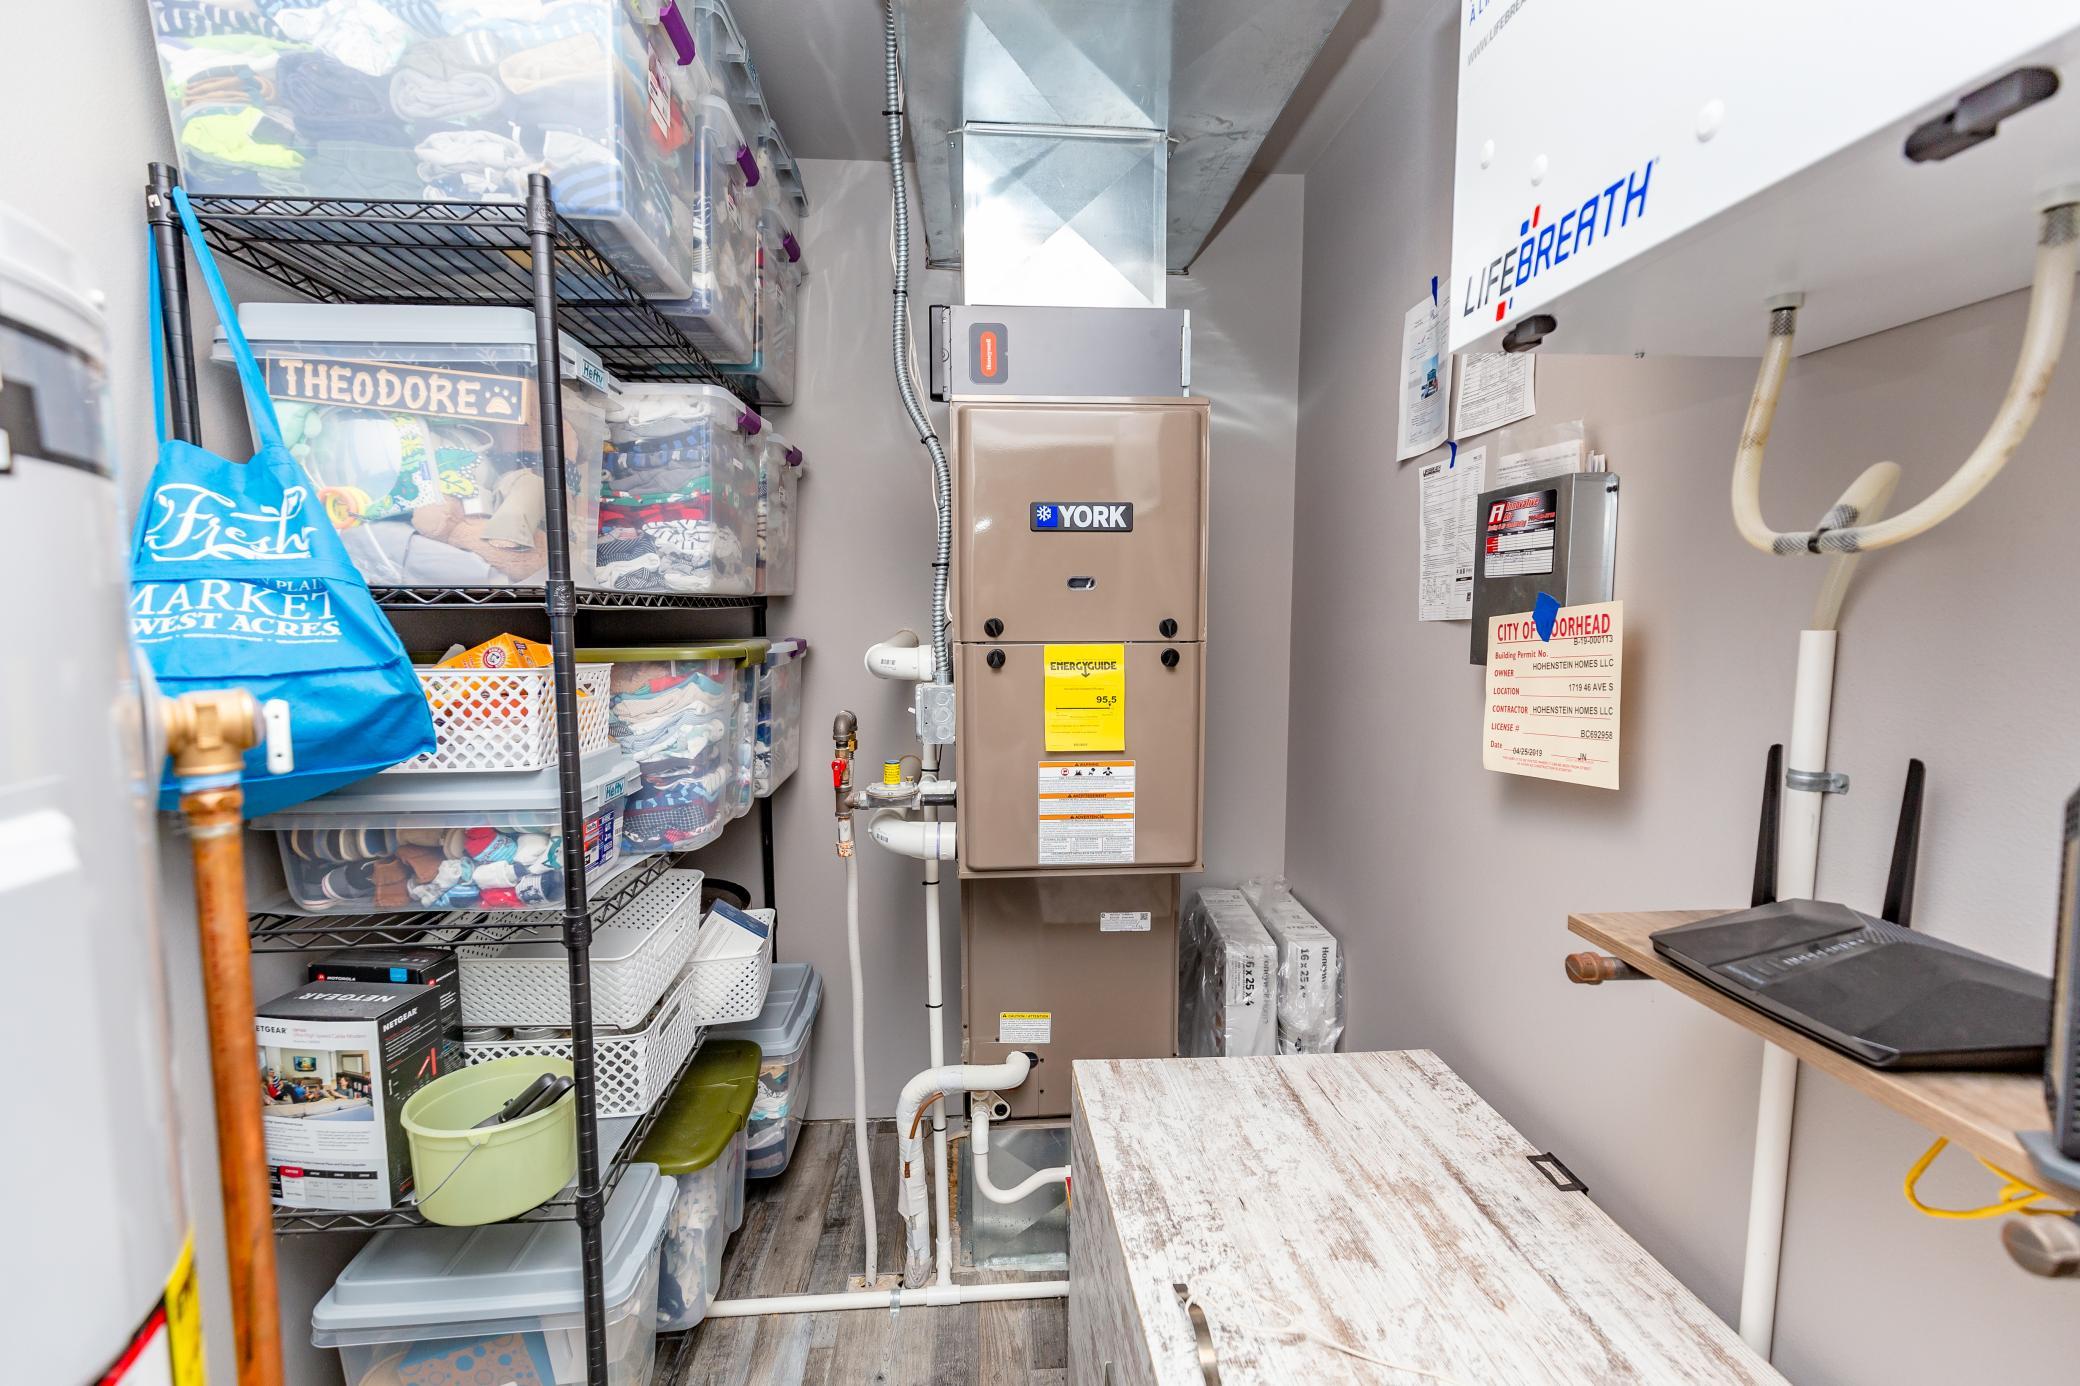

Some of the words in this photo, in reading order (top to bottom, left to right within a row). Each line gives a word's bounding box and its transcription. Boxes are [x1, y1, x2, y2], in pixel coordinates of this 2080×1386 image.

[1463, 159, 1654, 318] LIFEBREATH
[583, 361, 604, 386] Hefty
[279, 359, 481, 415] THEODORE
[145, 483, 318, 554] Fresh
[1058, 505, 1127, 528] YORK
[129, 611, 223, 636] WEST
[228, 613, 343, 637] ACRES
[1497, 622, 1519, 642] CITY
[1522, 621, 1536, 639] OF
[1551, 613, 1611, 638] OORHEAD
[1495, 651, 1516, 661] Building
[1517, 651, 1536, 659] Permit
[1538, 649, 1549, 658] No.
[1050, 661, 1117, 673] ENERGYGUIDE
[1532, 661, 1574, 671] HOHENSTEIN
[1574, 659, 1598, 669] HOMES
[1600, 658, 1614, 668] LLC
[1494, 669, 1514, 677] OWNER
[1493, 687, 1520, 696] LOCATION
[1568, 683, 1583, 692] 1719
[1583, 683, 1592, 692] 46
[1592, 682, 1607, 692] AVE
[1608, 682, 1614, 691] S
[1492, 705, 1529, 714] CONTRACTOR
[1532, 705, 1573, 715] HOHENSTEIN
[1574, 706, 1598, 715] HOMES
[1599, 706, 1614, 716] LLC
[1490, 722, 1514, 731] LICENSE
[1490, 740, 1503, 749] Date
[605, 782, 624, 800] Hefty
[1245, 978, 1255, 990] 25
[297, 992, 398, 1003] NETGEAR
[382, 1007, 418, 1032] NETGEAR
[254, 1024, 288, 1035] ETGEAR
